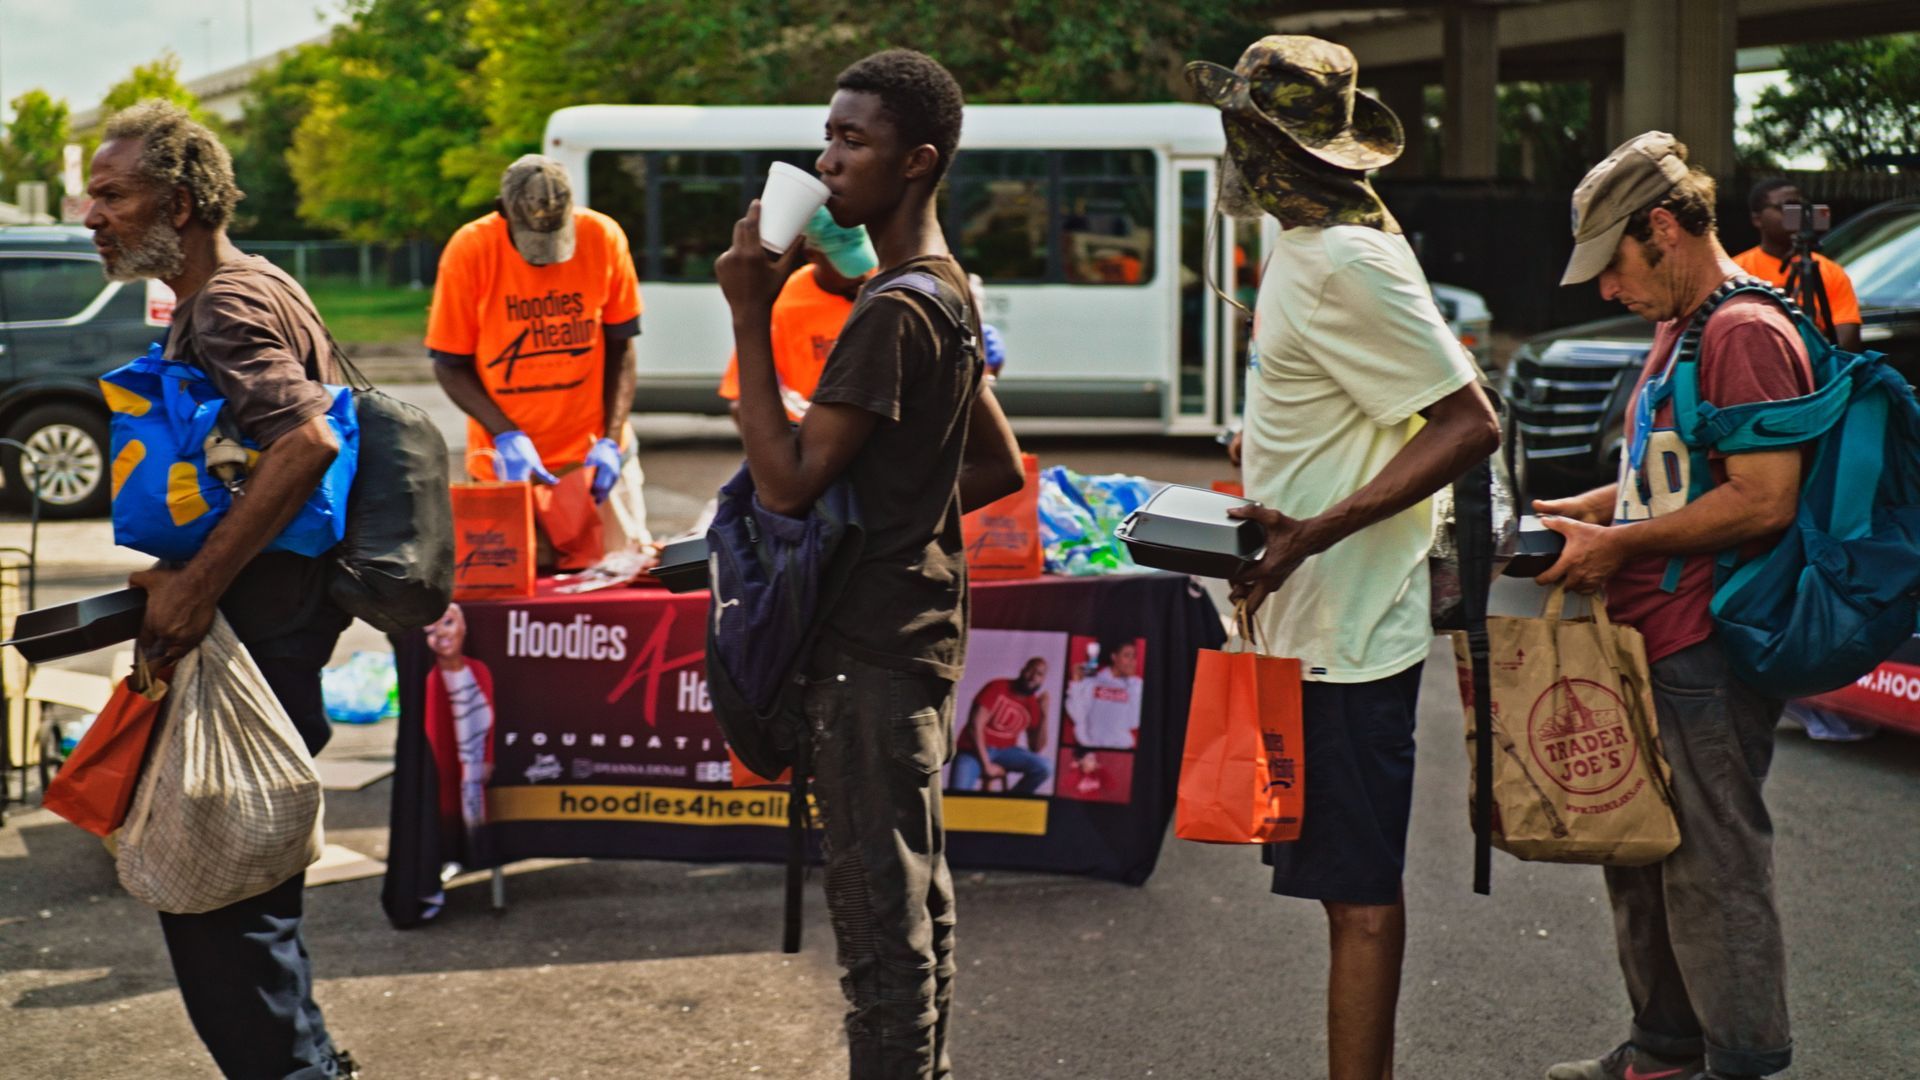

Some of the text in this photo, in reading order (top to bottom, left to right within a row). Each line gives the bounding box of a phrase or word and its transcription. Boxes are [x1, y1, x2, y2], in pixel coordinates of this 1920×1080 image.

[506, 290, 584, 323] Hoodies
[507, 609, 629, 662] Hoodies
[505, 732, 730, 752] FOUNDATI
[1545, 725, 1629, 763] TRADER
[1560, 750, 1622, 783] JOE'S
